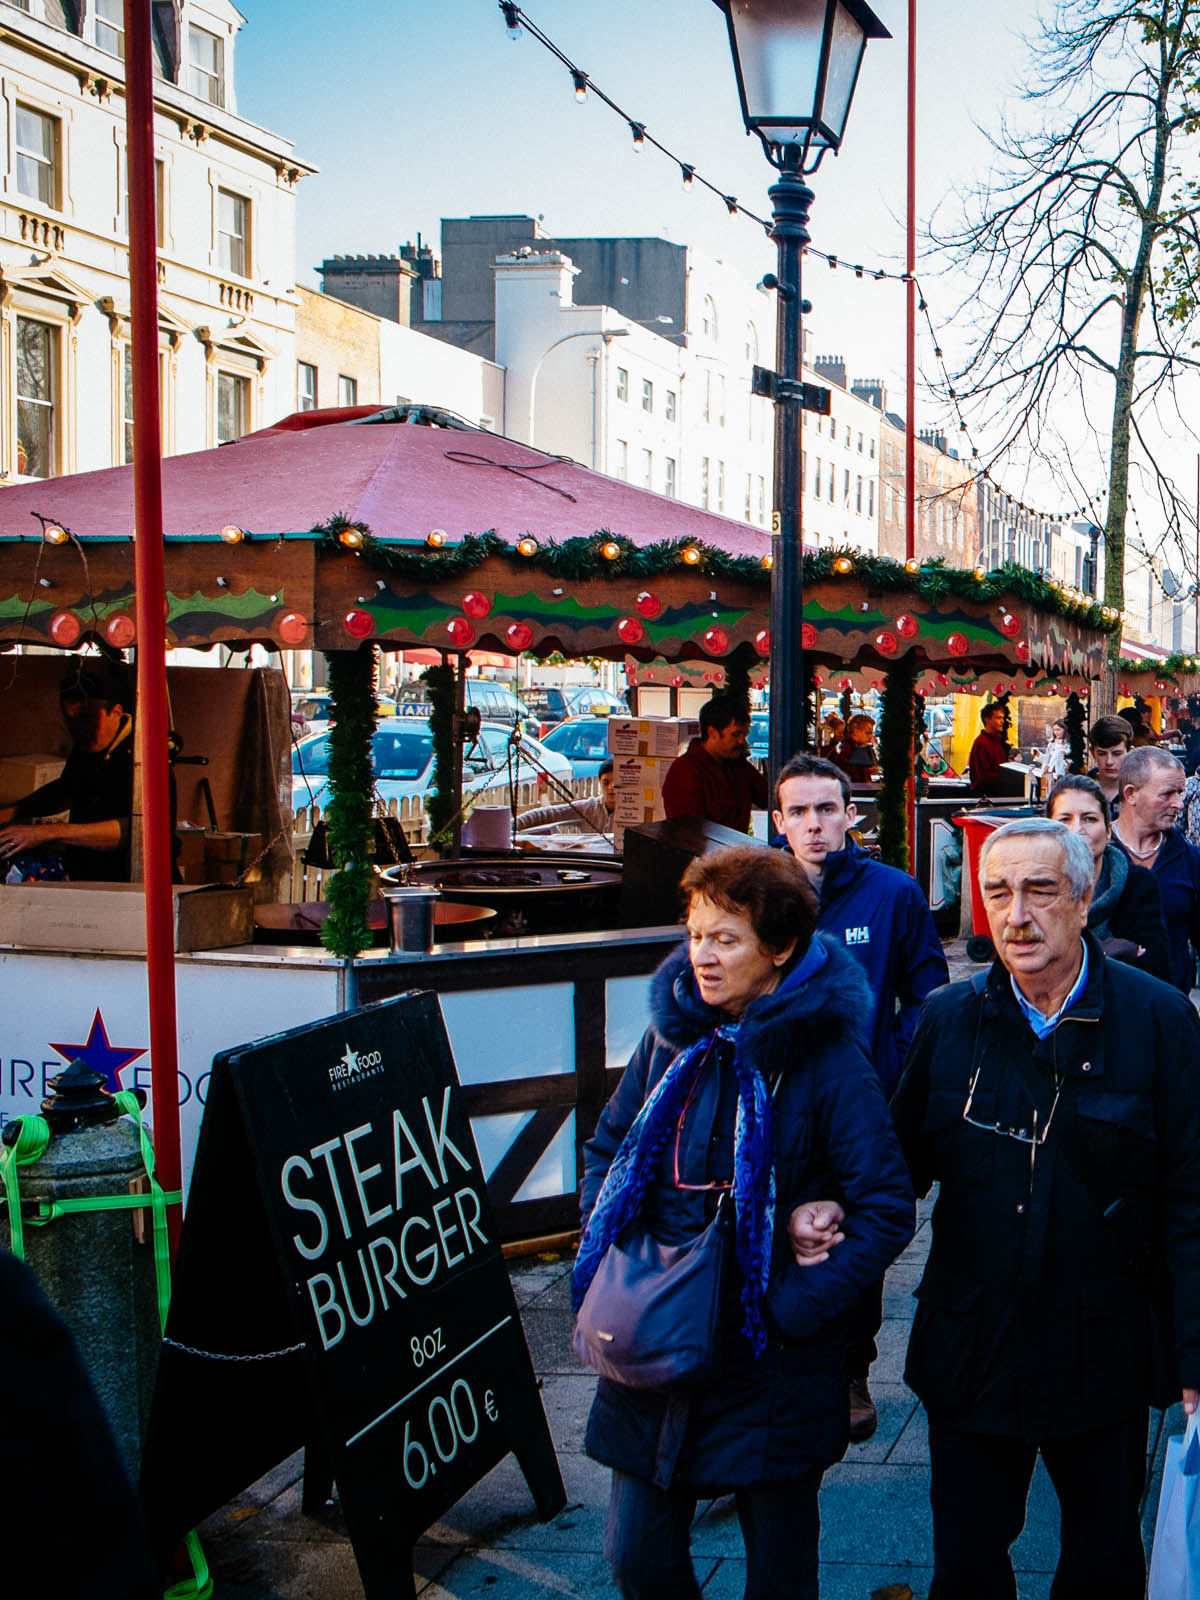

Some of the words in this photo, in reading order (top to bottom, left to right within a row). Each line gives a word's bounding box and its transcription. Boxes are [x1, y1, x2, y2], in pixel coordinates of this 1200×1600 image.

[845, 926, 869, 941] HH
[328, 1063, 348, 1081] FIRE
[357, 1051, 382, 1070] FOOD
[332, 1065, 384, 1091] RESTAURANTS
[281, 1086, 473, 1261] STEAK
[307, 1187, 489, 1351] BURGER
[485, 1389, 499, 1422] €
